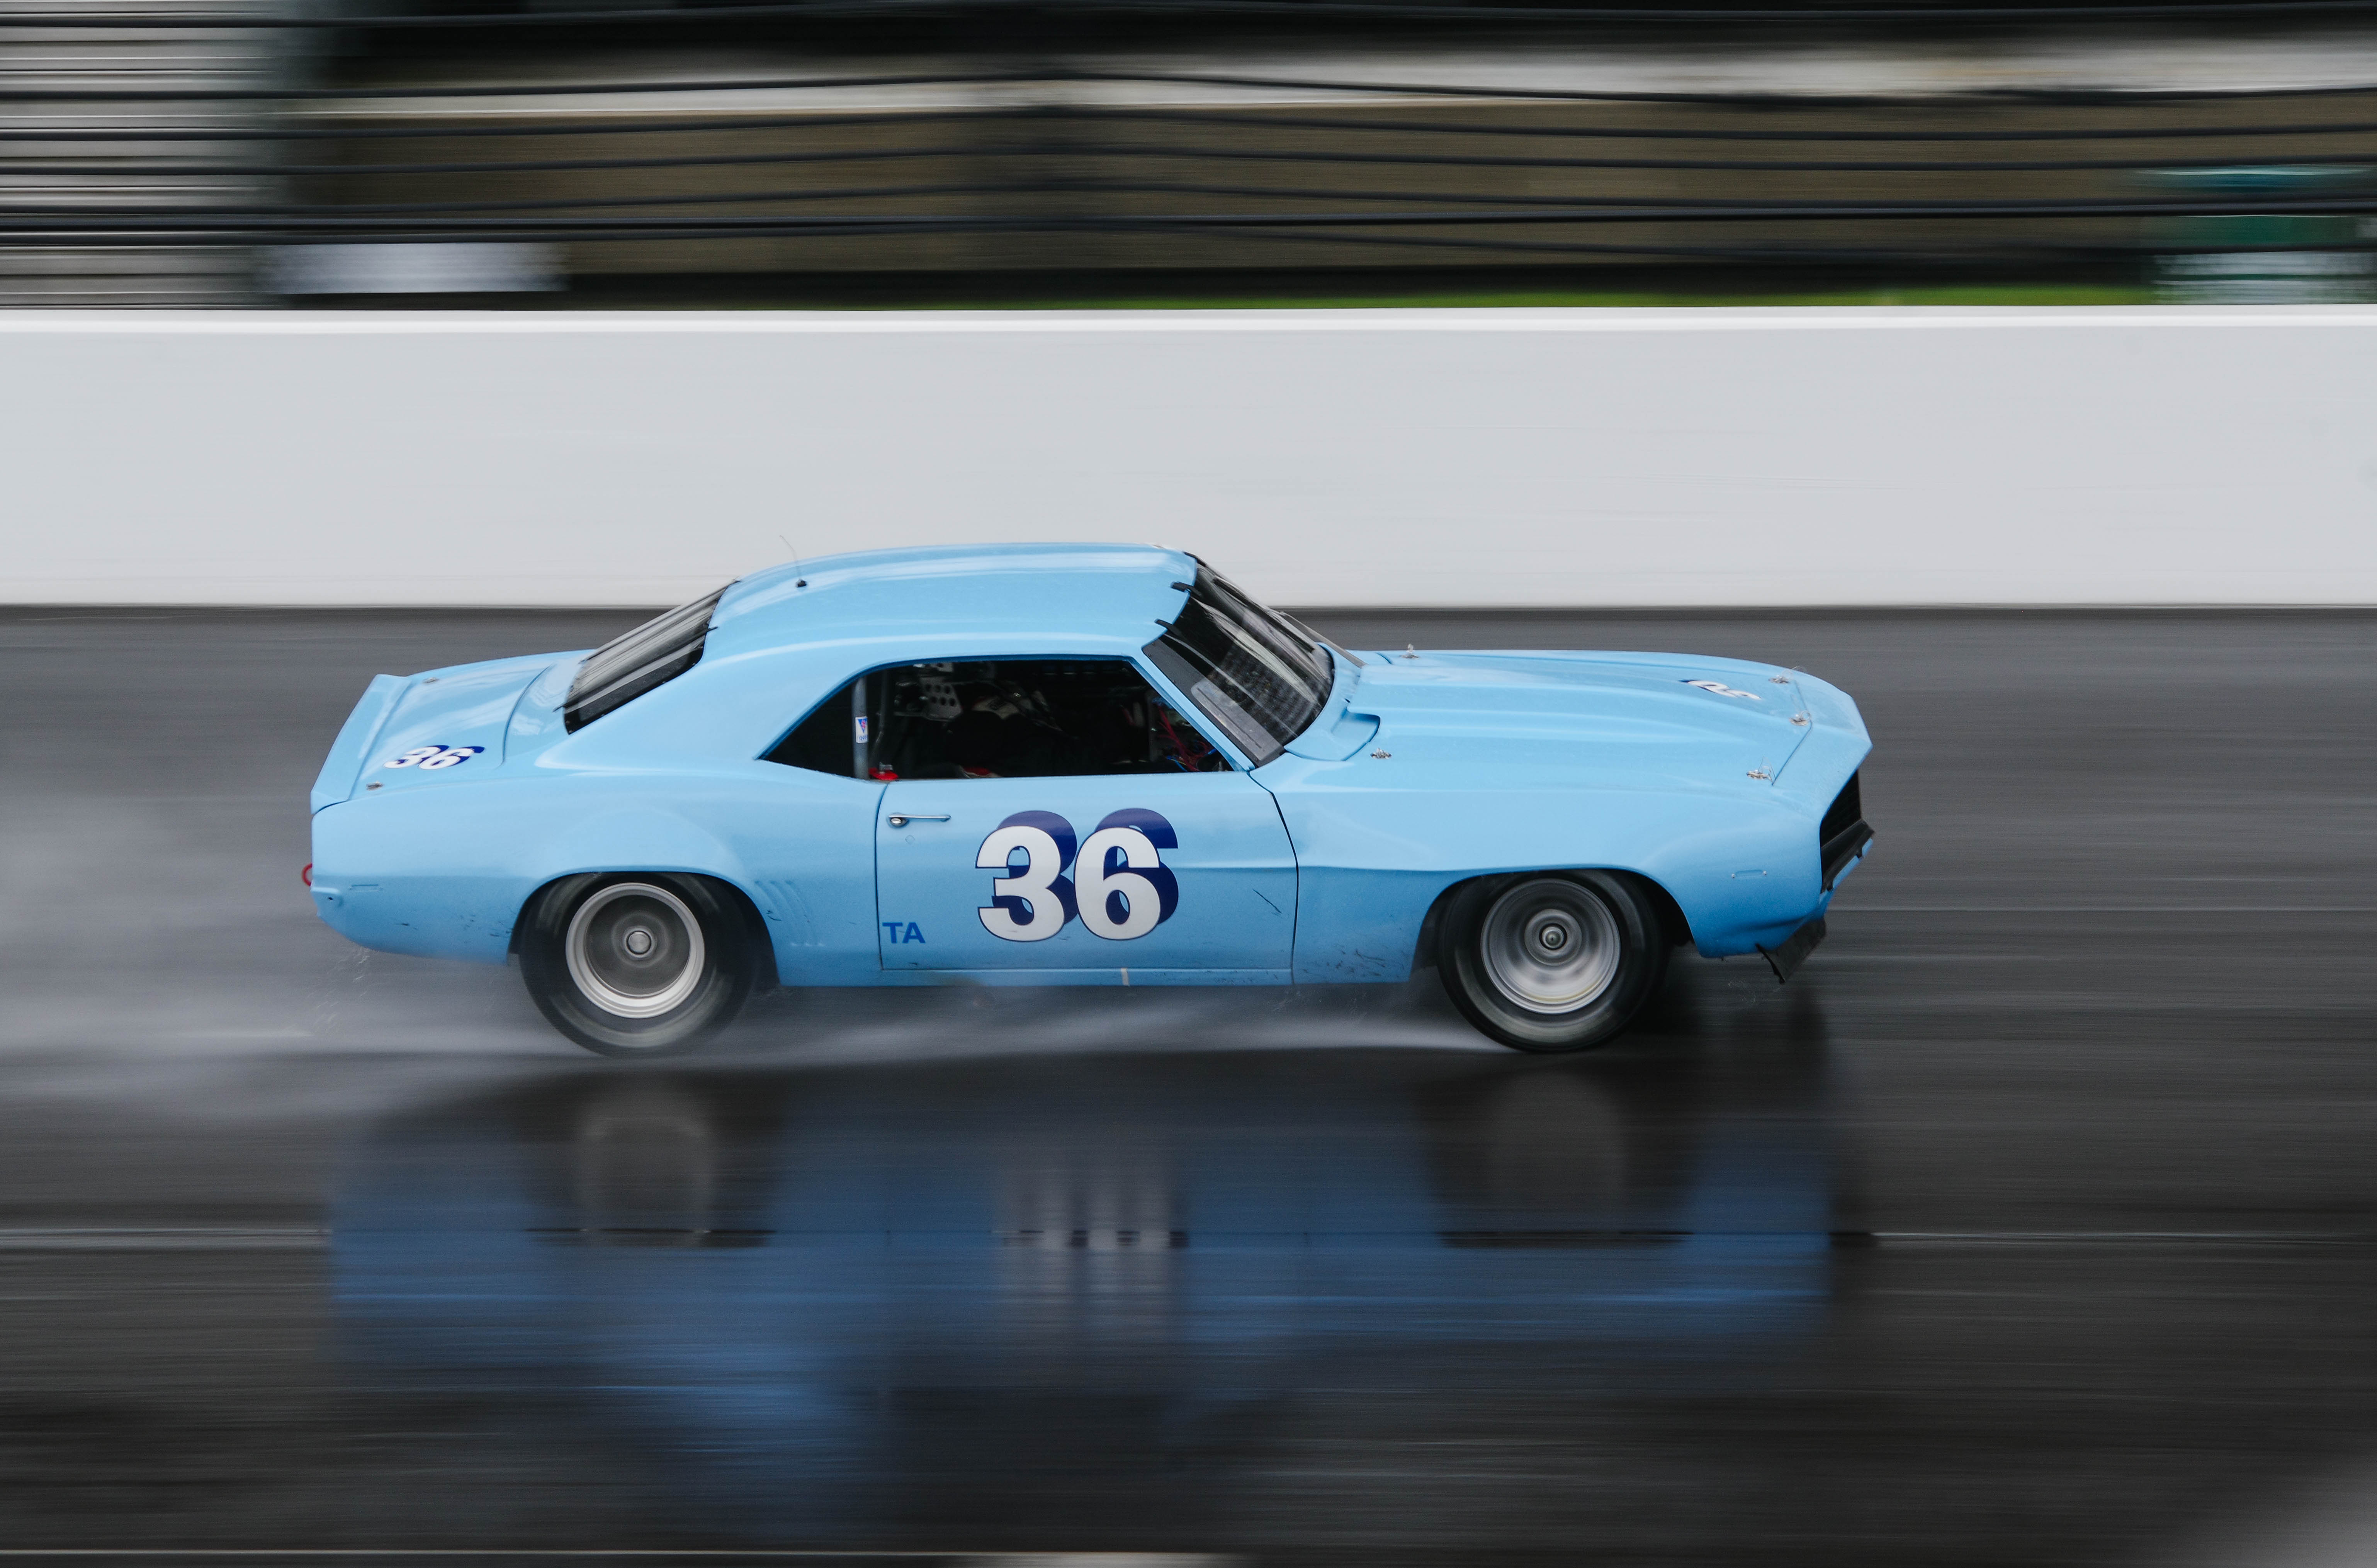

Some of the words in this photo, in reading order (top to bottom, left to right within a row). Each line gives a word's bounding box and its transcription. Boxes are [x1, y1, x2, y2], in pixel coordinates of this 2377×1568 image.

[384, 745, 485, 770] 36
[975, 808, 1179, 942] 36
[882, 922, 925, 944] TA
